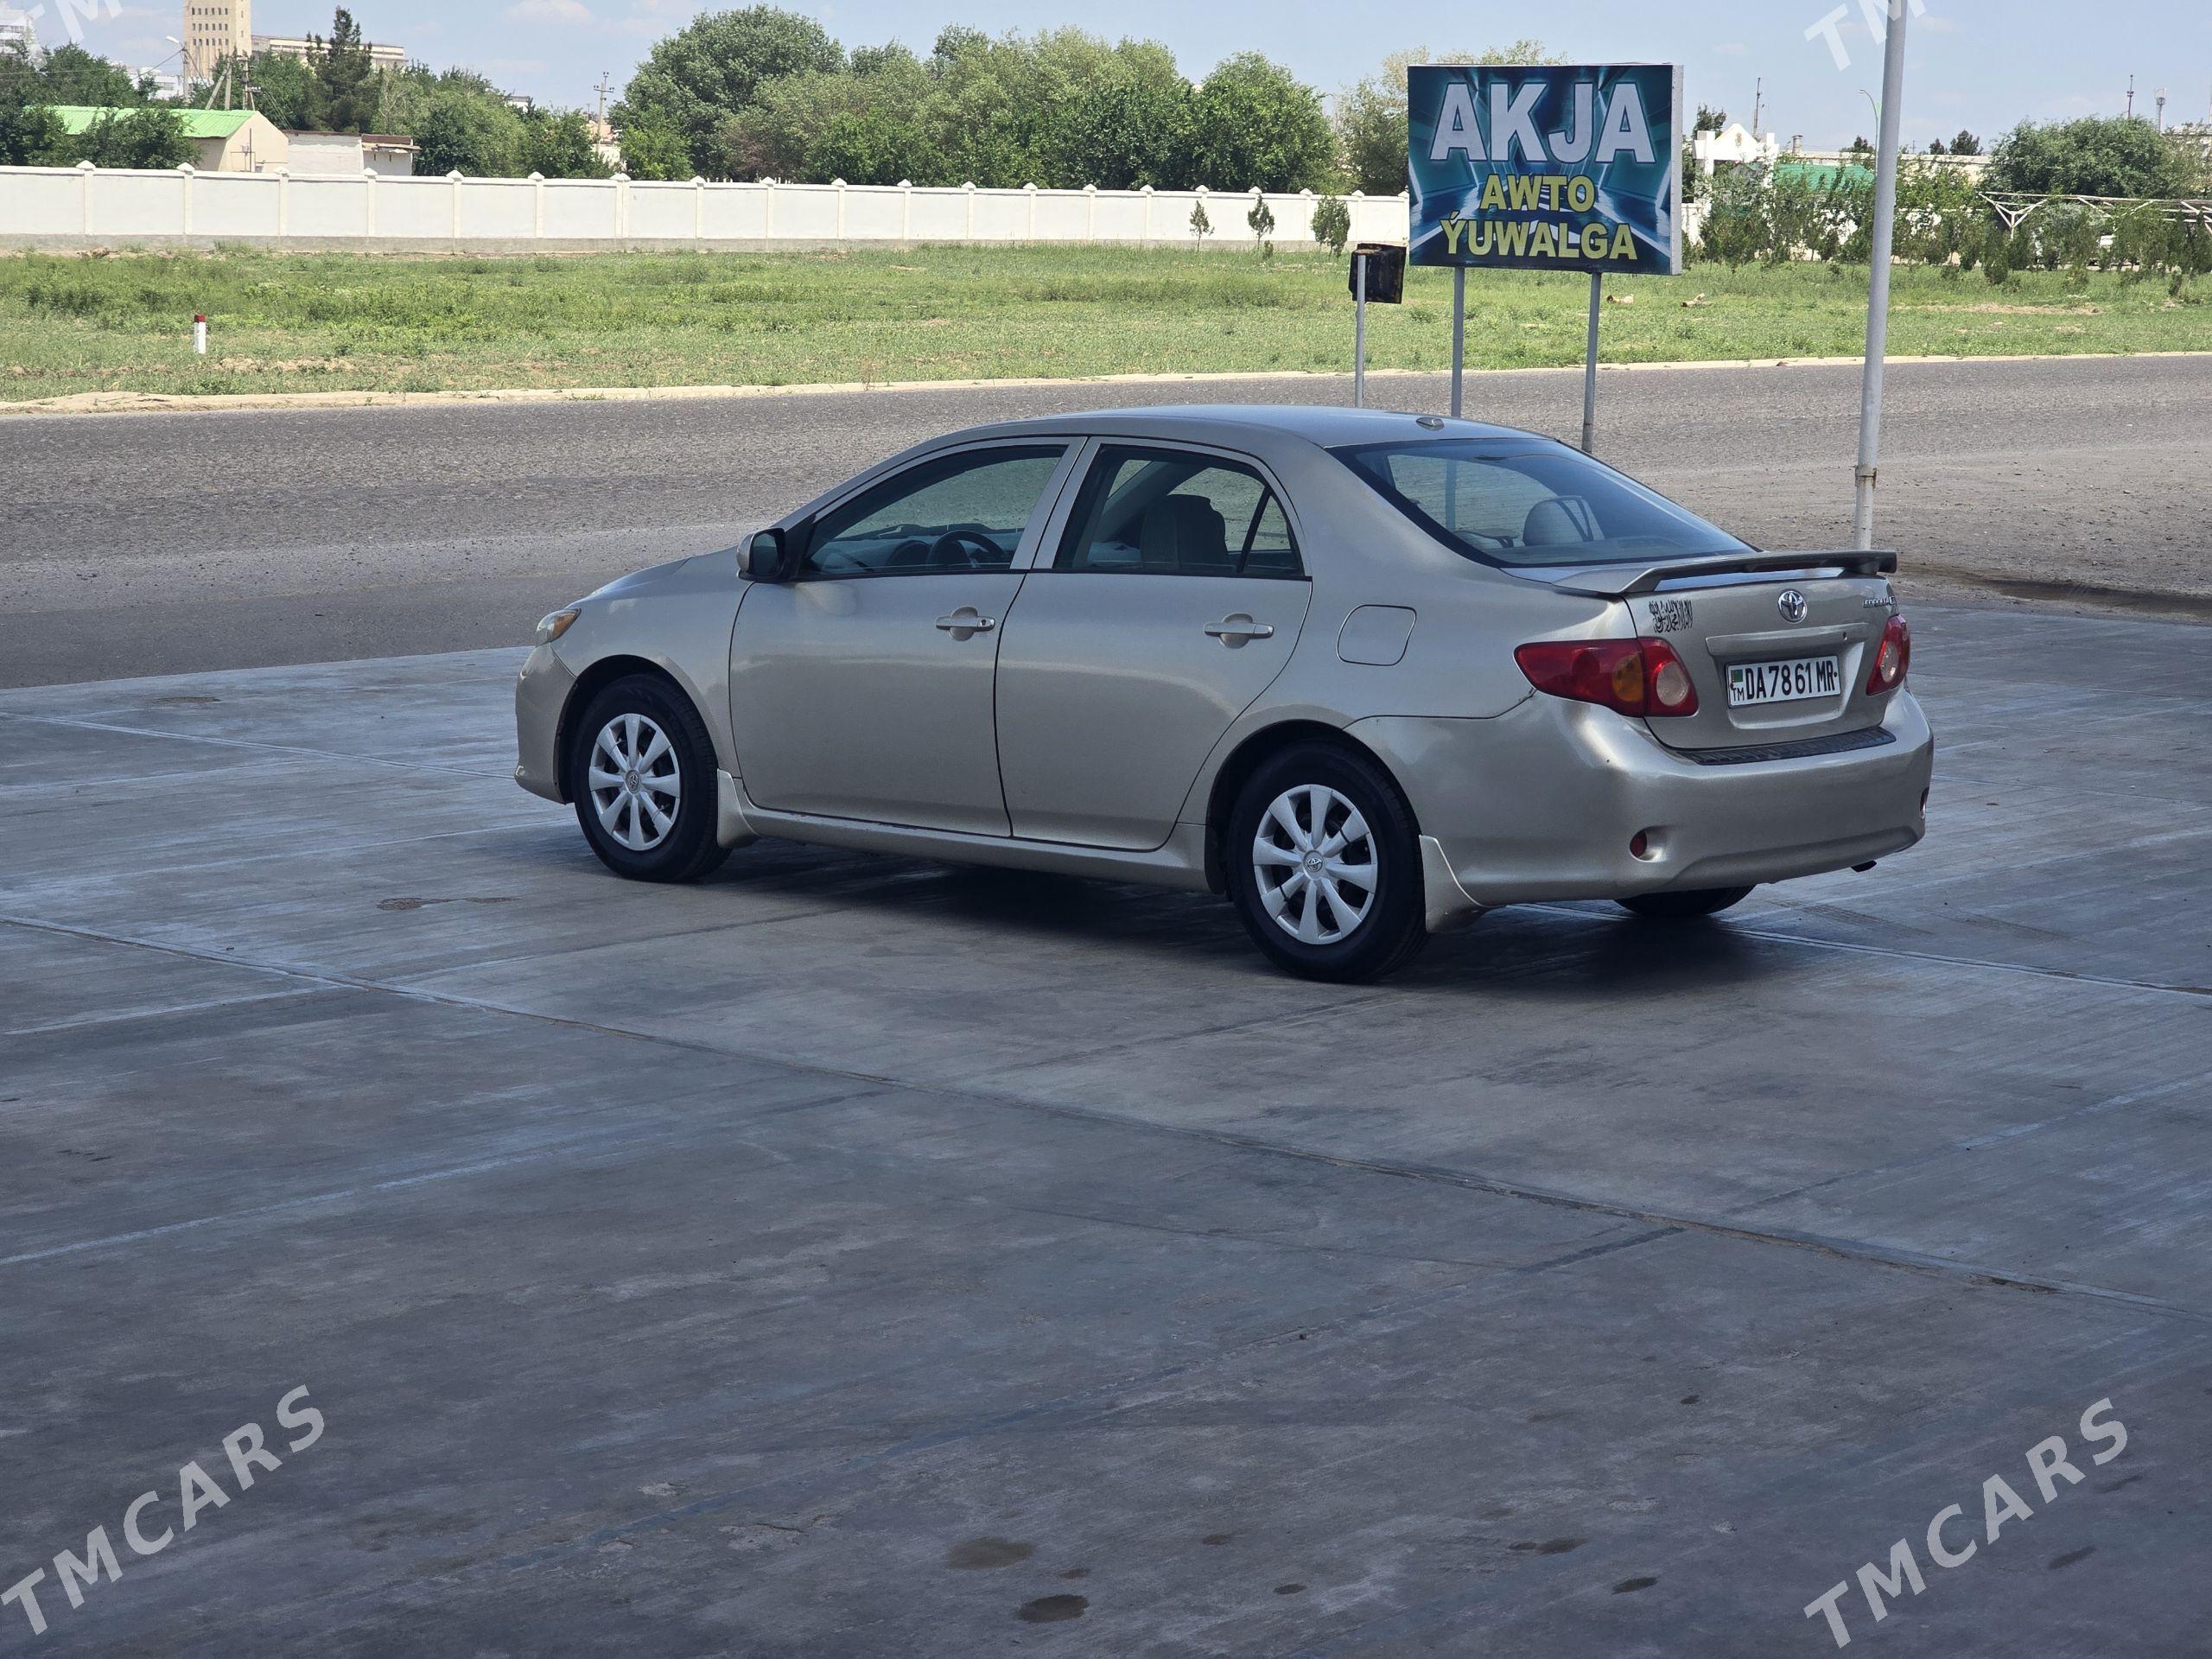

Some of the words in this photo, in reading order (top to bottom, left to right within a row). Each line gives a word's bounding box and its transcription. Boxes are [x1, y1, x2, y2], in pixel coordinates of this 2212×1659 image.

[1429, 82, 1656, 163] AKJA
[1479, 175, 1595, 213] AWTO
[1440, 211, 1638, 259] ÝUWALGA
